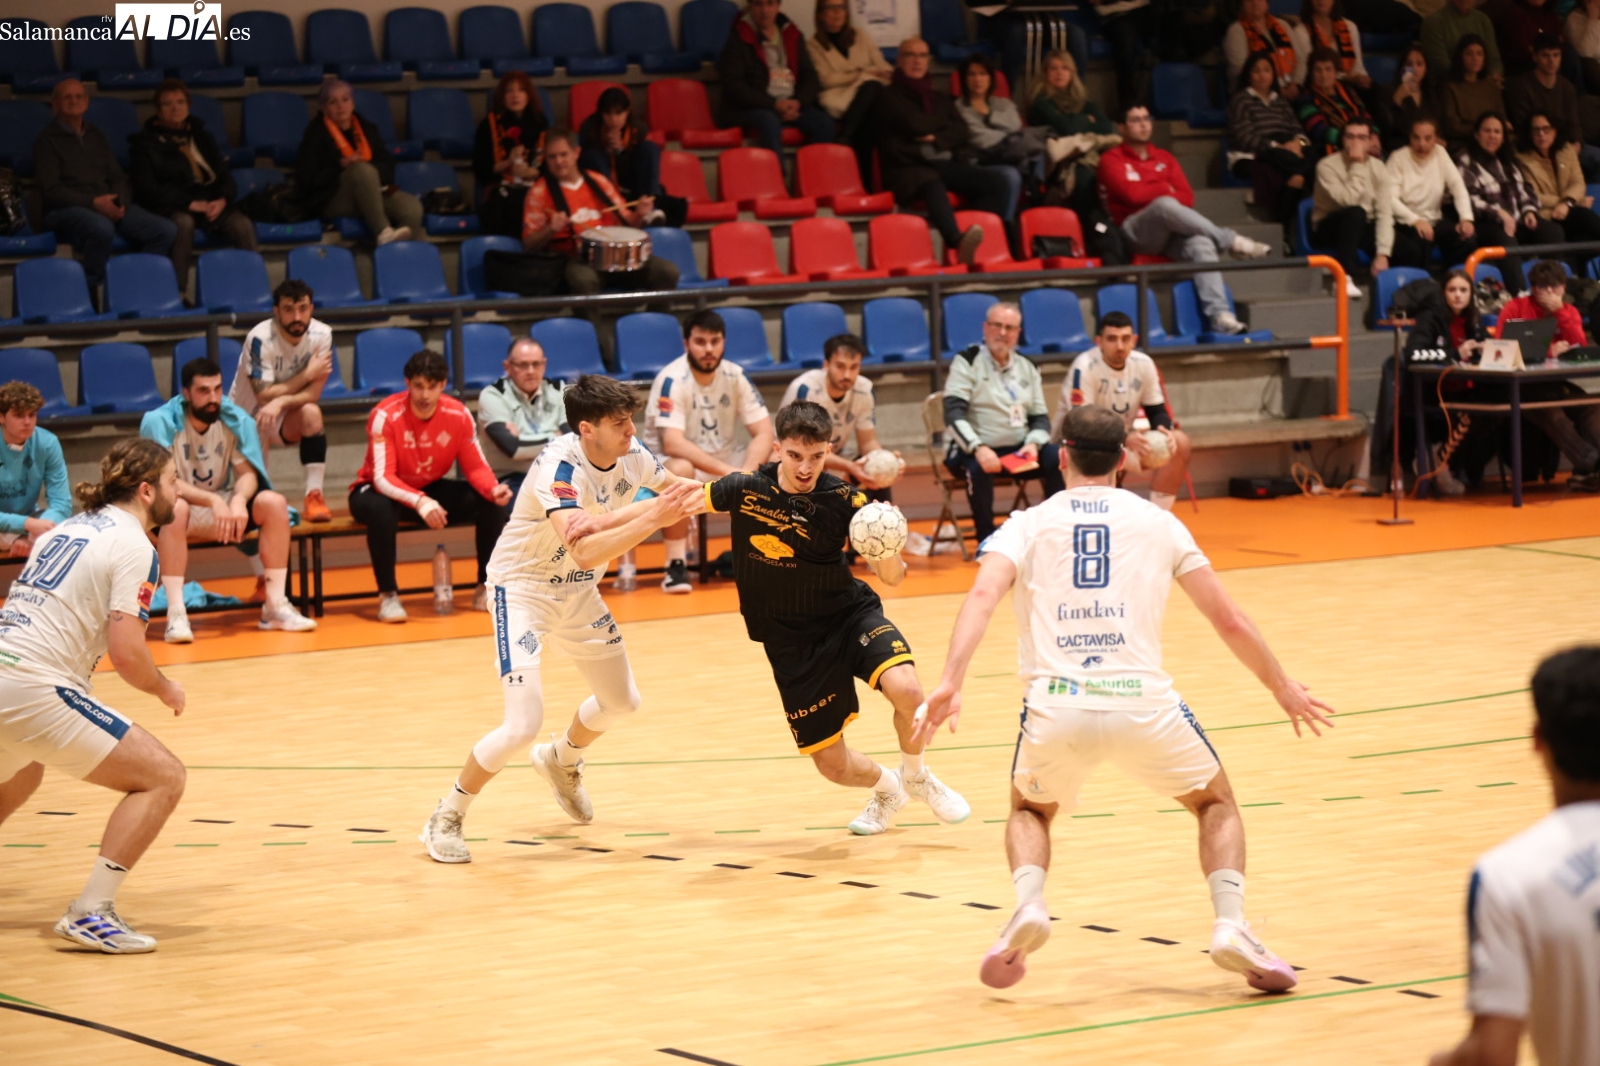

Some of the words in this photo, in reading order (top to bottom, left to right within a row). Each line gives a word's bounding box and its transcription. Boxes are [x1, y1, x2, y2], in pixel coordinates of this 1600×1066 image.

[741, 495, 790, 522] Sanalón
[1070, 499, 1109, 514] PUIG
[748, 552, 784, 567] CONGESA
[1073, 524, 1110, 589] 8
[1057, 600, 1125, 621] fundavi
[1085, 677, 1142, 689] Asturias
